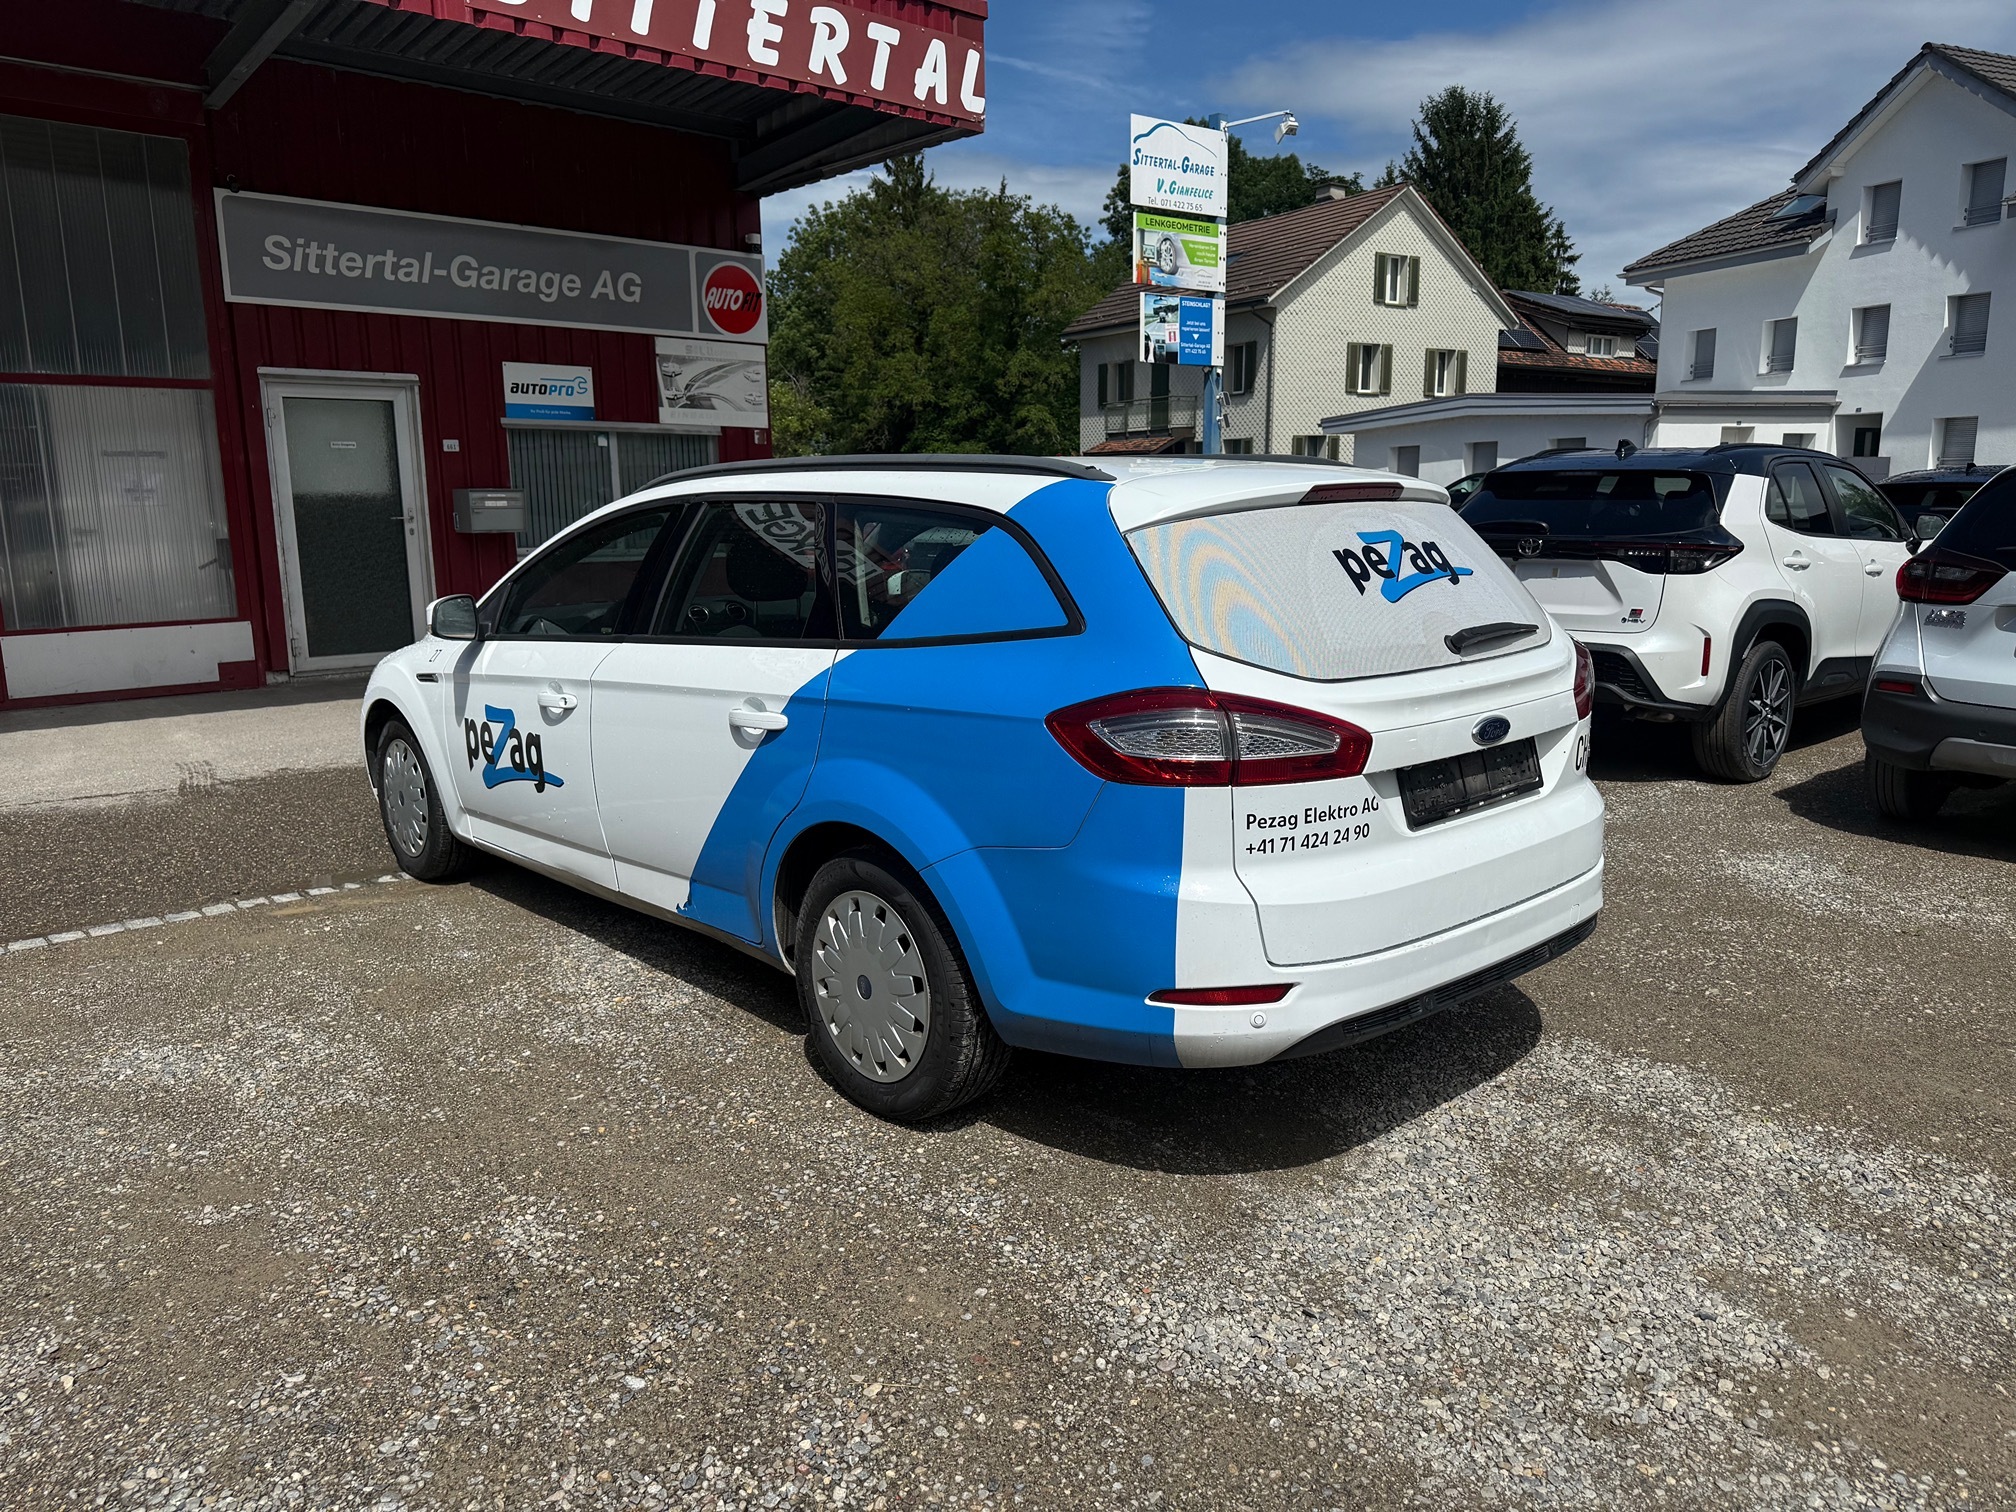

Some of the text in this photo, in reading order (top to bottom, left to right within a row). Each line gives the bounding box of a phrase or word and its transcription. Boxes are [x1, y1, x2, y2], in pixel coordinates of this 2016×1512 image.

[1133, 148, 1215, 177] SITTERTAL-GARAGE
[1148, 197, 1203, 212] Tel. 071 422 75 65
[1145, 217, 1211, 234] LENKGEOMETRIE
[262, 234, 642, 304] Sittertal-Garage AG
[1483, 722, 1506, 740] Ford
[1246, 795, 1379, 830] Pezag Elektro AG
[1245, 823, 1370, 855] +41 71 424 24 90
